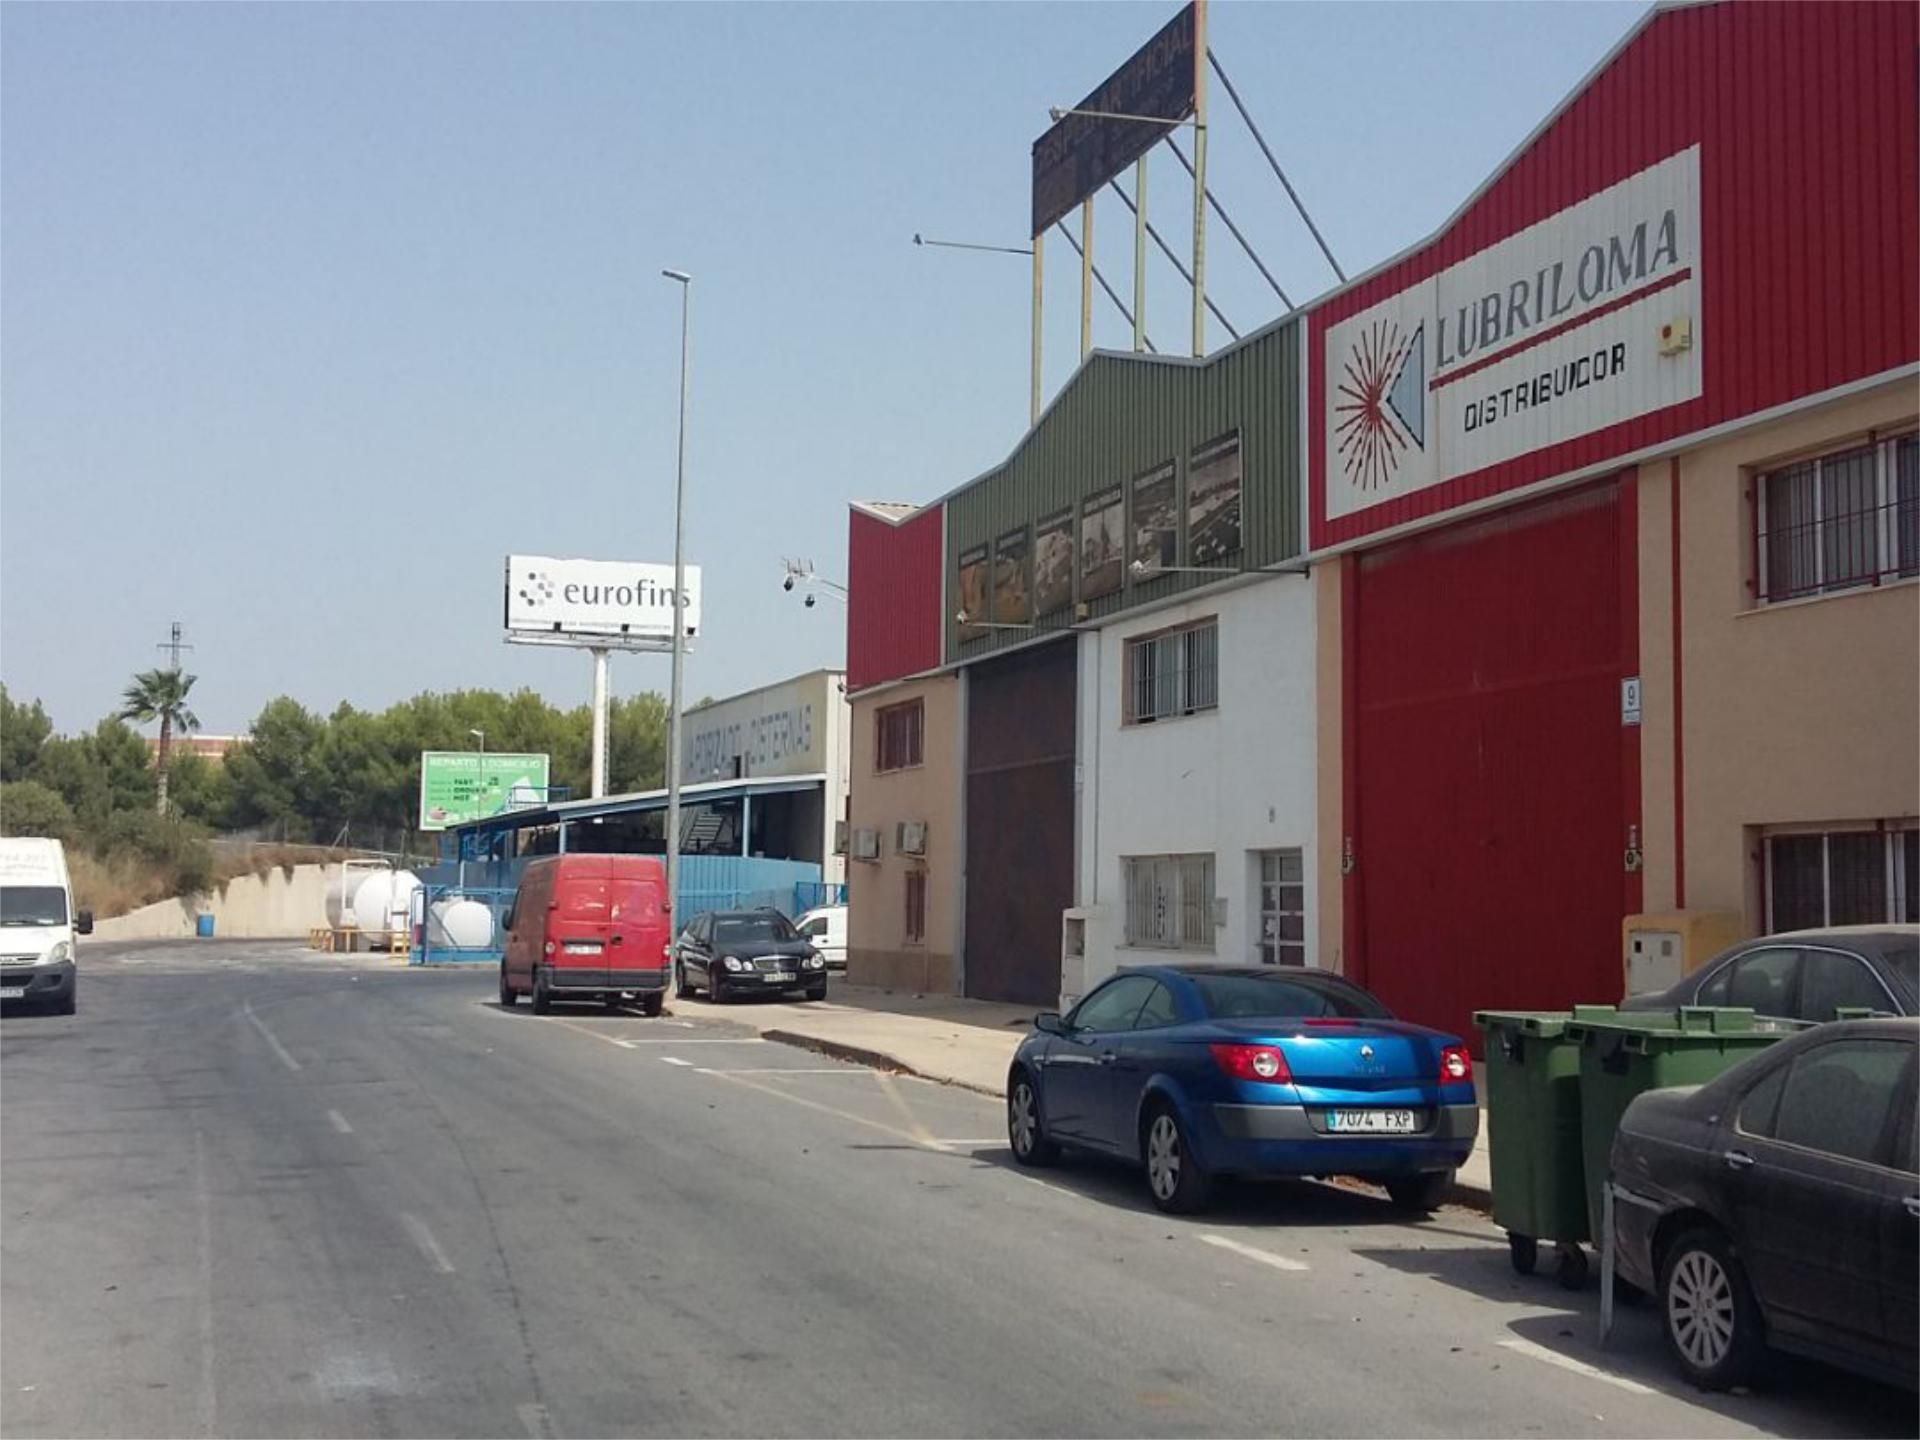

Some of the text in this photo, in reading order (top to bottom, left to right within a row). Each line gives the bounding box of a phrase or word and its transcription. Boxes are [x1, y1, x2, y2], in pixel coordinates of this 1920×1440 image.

[1436, 209, 1679, 368] LUBRILOMA
[1627, 685, 1636, 706] 9
[1337, 1110, 1410, 1127] 7074 FXP
